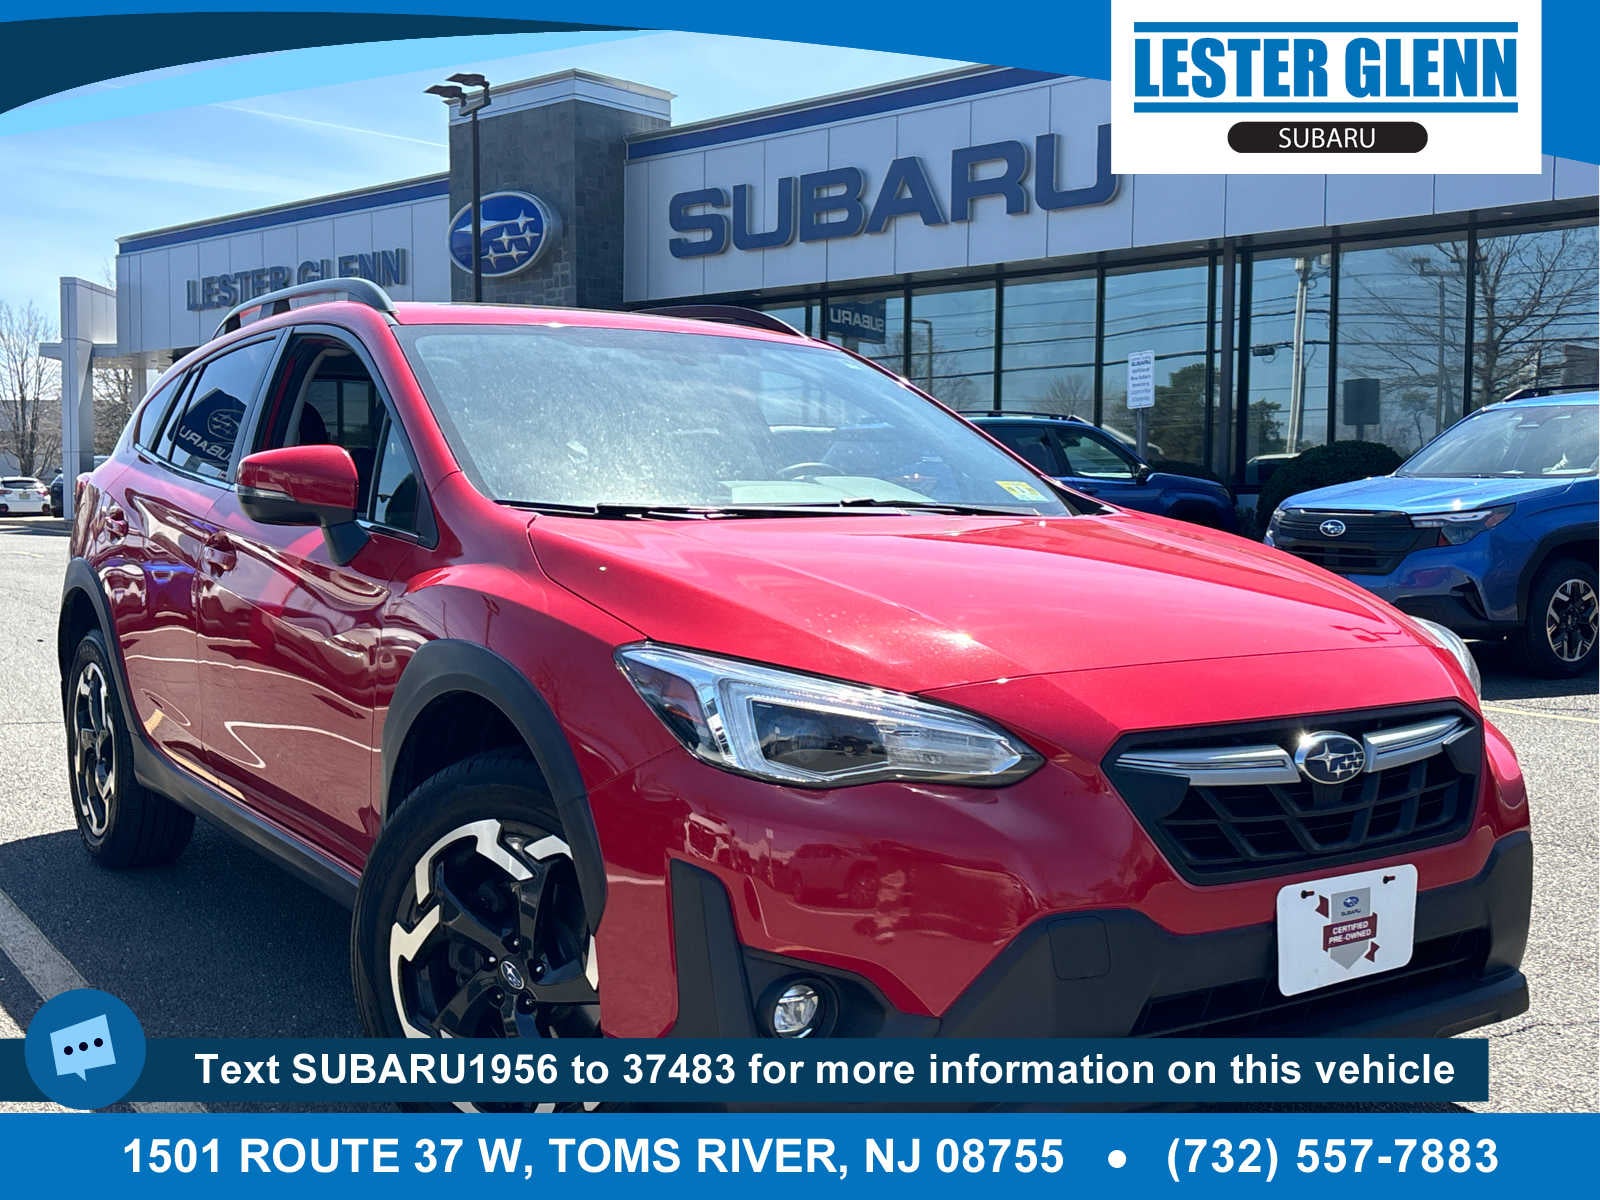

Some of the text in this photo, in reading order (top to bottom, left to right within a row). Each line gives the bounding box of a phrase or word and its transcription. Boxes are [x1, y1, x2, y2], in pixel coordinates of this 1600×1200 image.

[669, 124, 1119, 260] SUBARU
[186, 265, 294, 311] LESTER
[1328, 928, 1372, 944] PRE-OWNED
[1332, 920, 1369, 935] CERTIFIED
